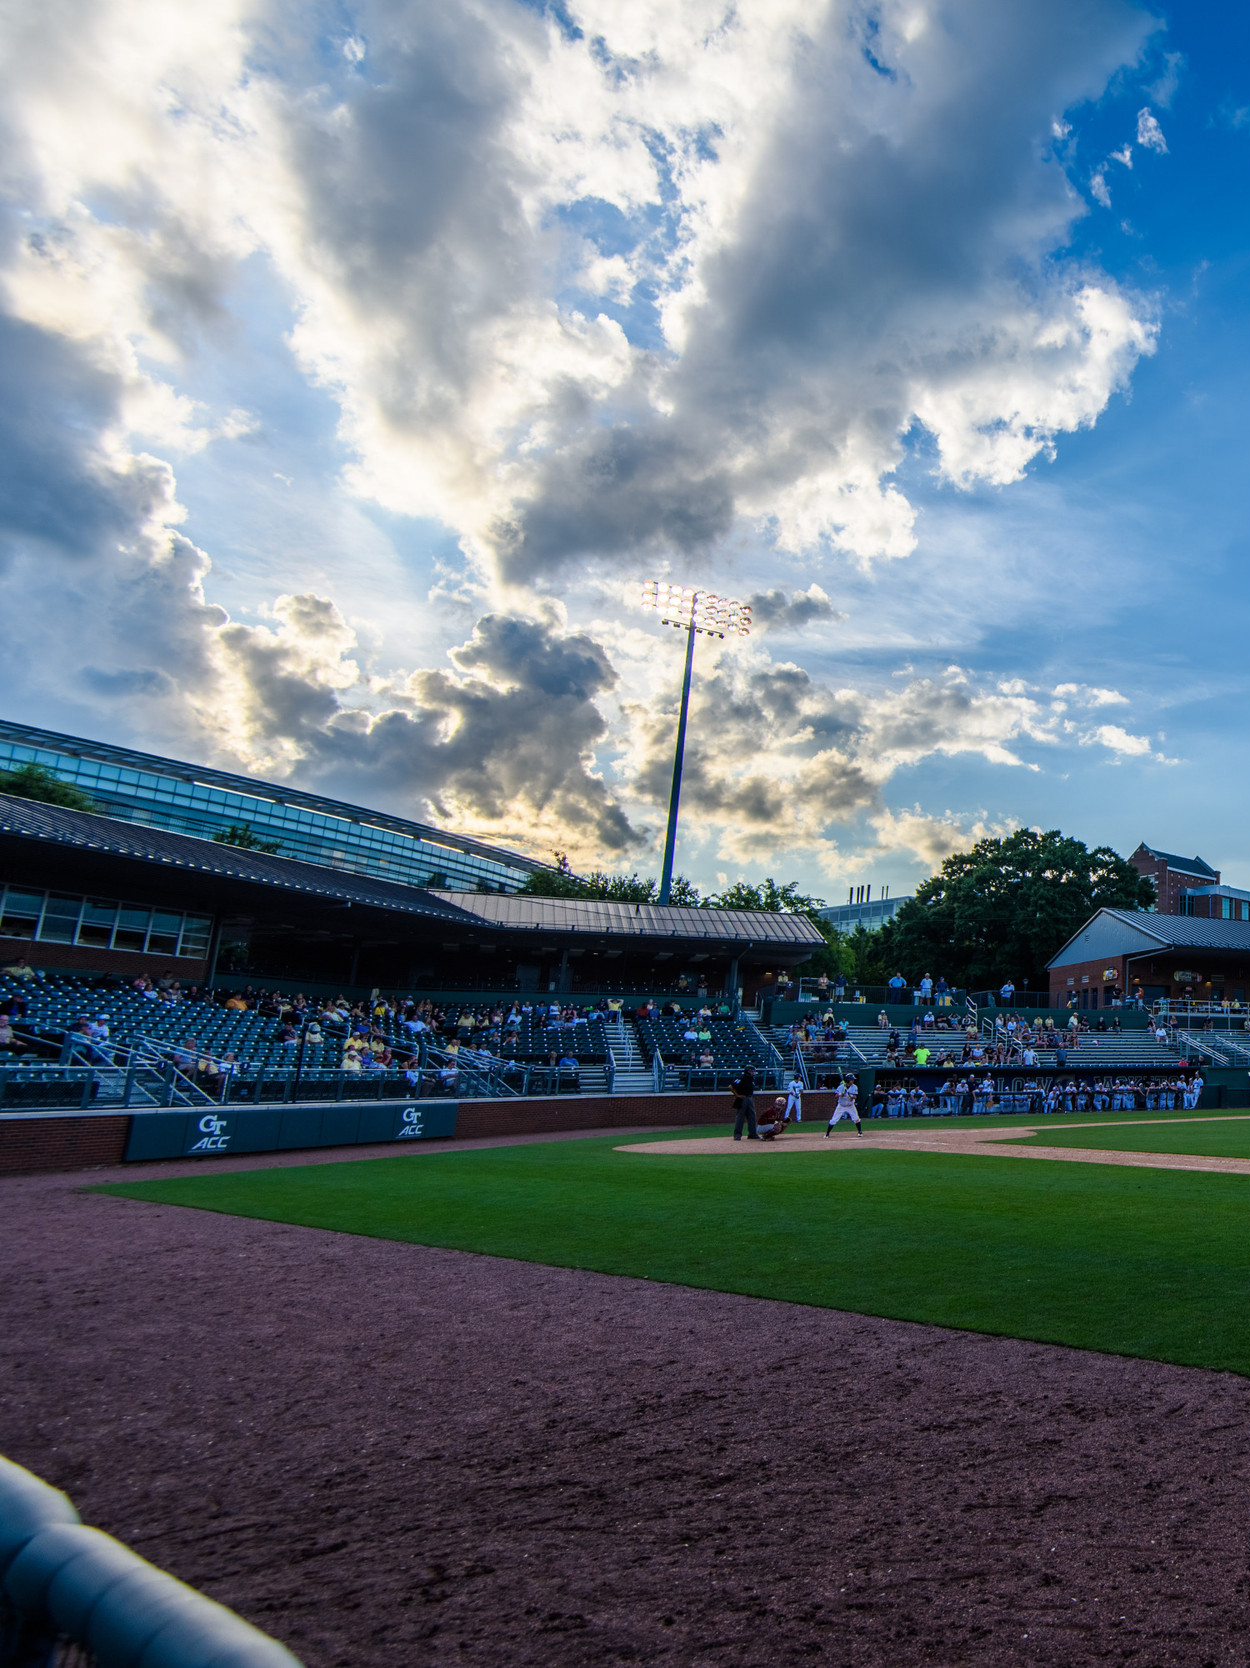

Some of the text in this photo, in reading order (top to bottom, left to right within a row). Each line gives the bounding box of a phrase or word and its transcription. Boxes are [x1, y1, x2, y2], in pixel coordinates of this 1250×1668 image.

[402, 1107, 422, 1124] GT
[199, 1114, 227, 1135] GT
[398, 1124, 424, 1136] ACC
[191, 1136, 231, 1150] ACC
